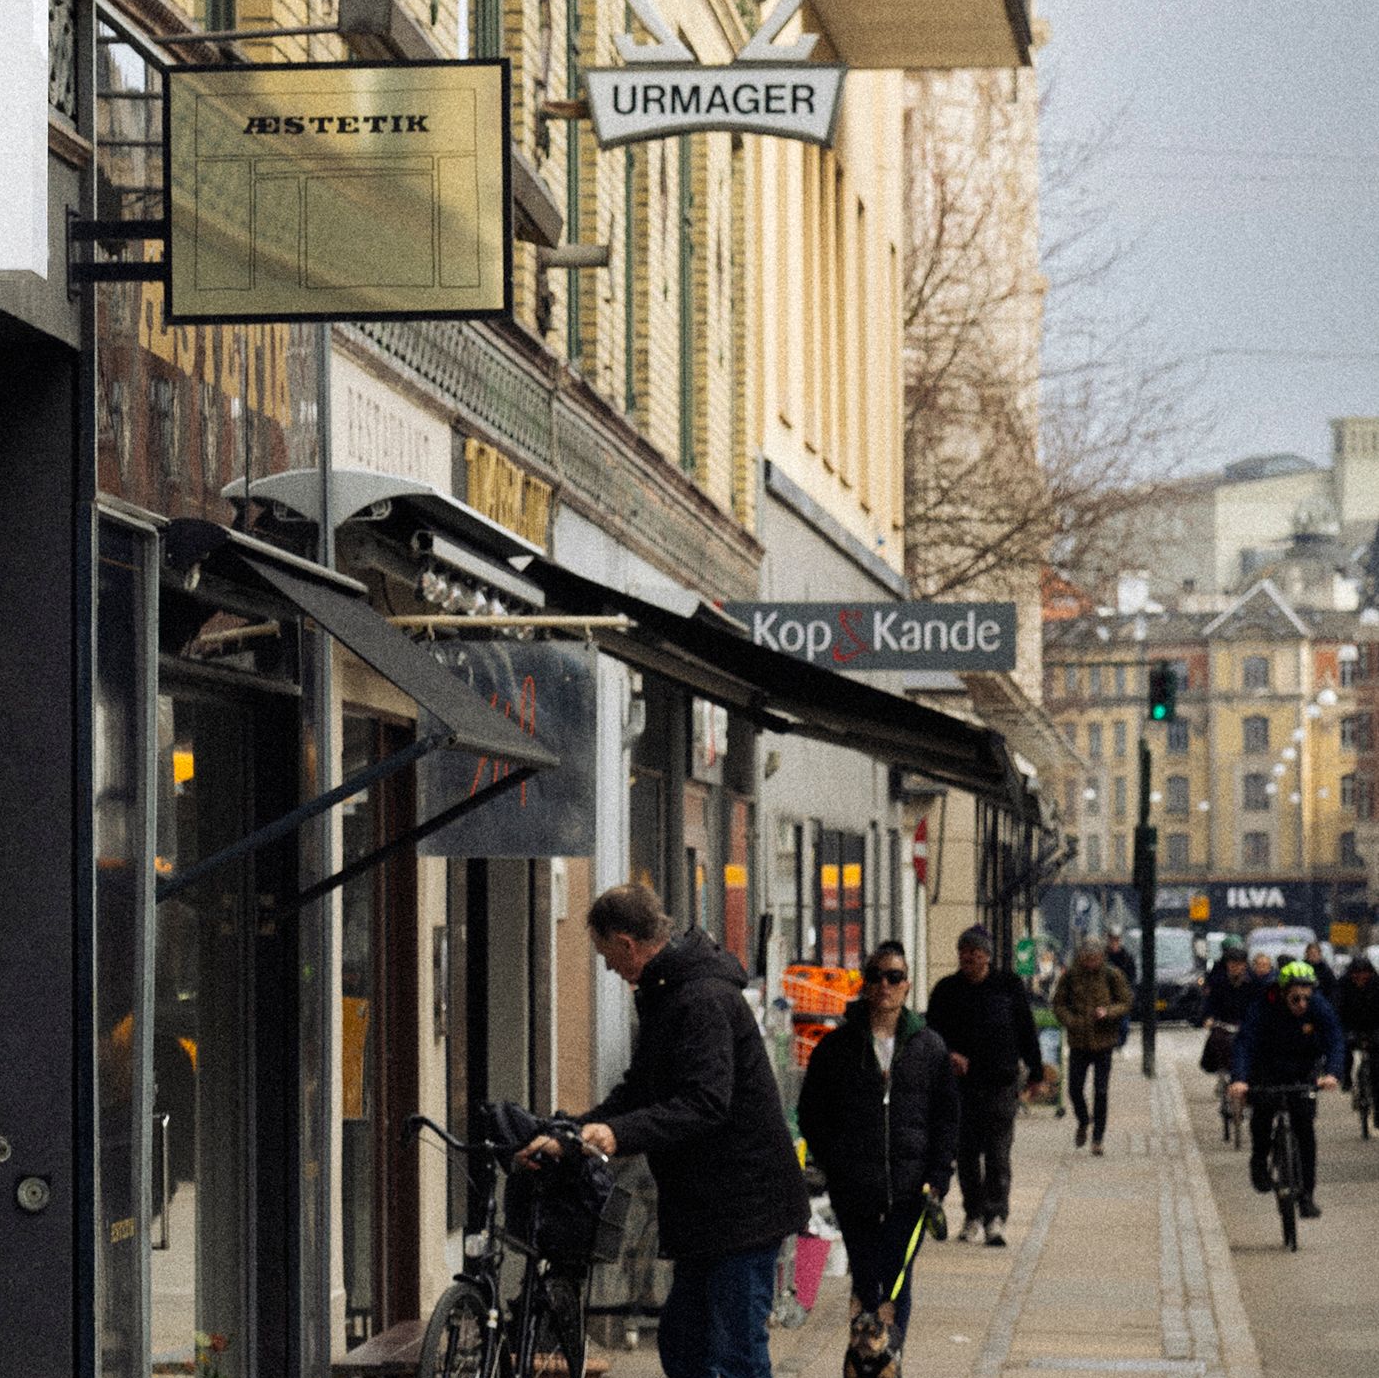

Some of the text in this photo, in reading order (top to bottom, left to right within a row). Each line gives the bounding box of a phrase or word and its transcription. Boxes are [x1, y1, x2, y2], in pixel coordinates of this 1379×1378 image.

[613, 84, 815, 115] URMAGER
[243, 114, 430, 135] ÆSTETIK
[753, 611, 832, 661] Kop
[873, 610, 1002, 652] Kande
[1228, 887, 1285, 908] ILVA
